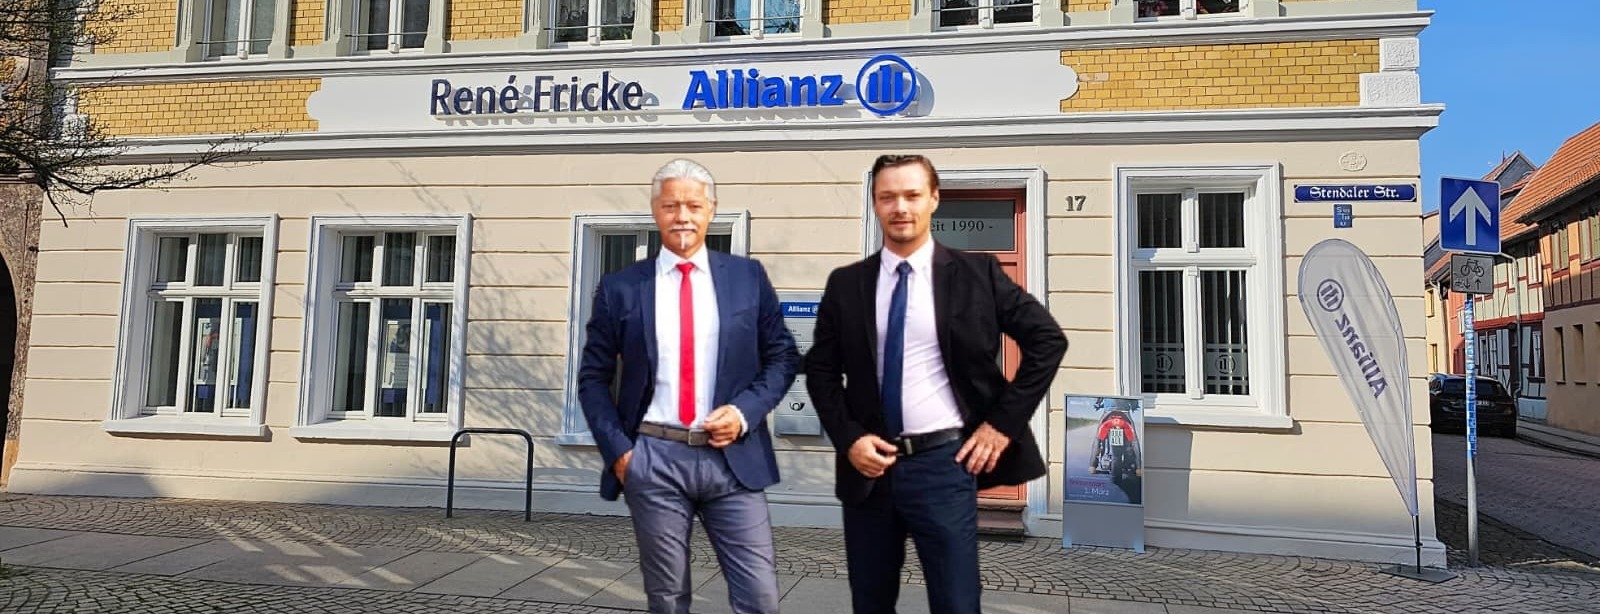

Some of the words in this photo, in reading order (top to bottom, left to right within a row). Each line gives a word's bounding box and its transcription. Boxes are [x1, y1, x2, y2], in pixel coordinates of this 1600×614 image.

[430, 75, 519, 115] René
[533, 71, 643, 112] Fricke
[682, 68, 844, 110] Allianz
[1309, 186, 1369, 199] Stendaler
[1373, 185, 1400, 198] Str.
[1065, 195, 1087, 211] 17
[930, 220, 945, 232] eit
[951, 220, 985, 232] 1990
[788, 305, 811, 313] Allianz
